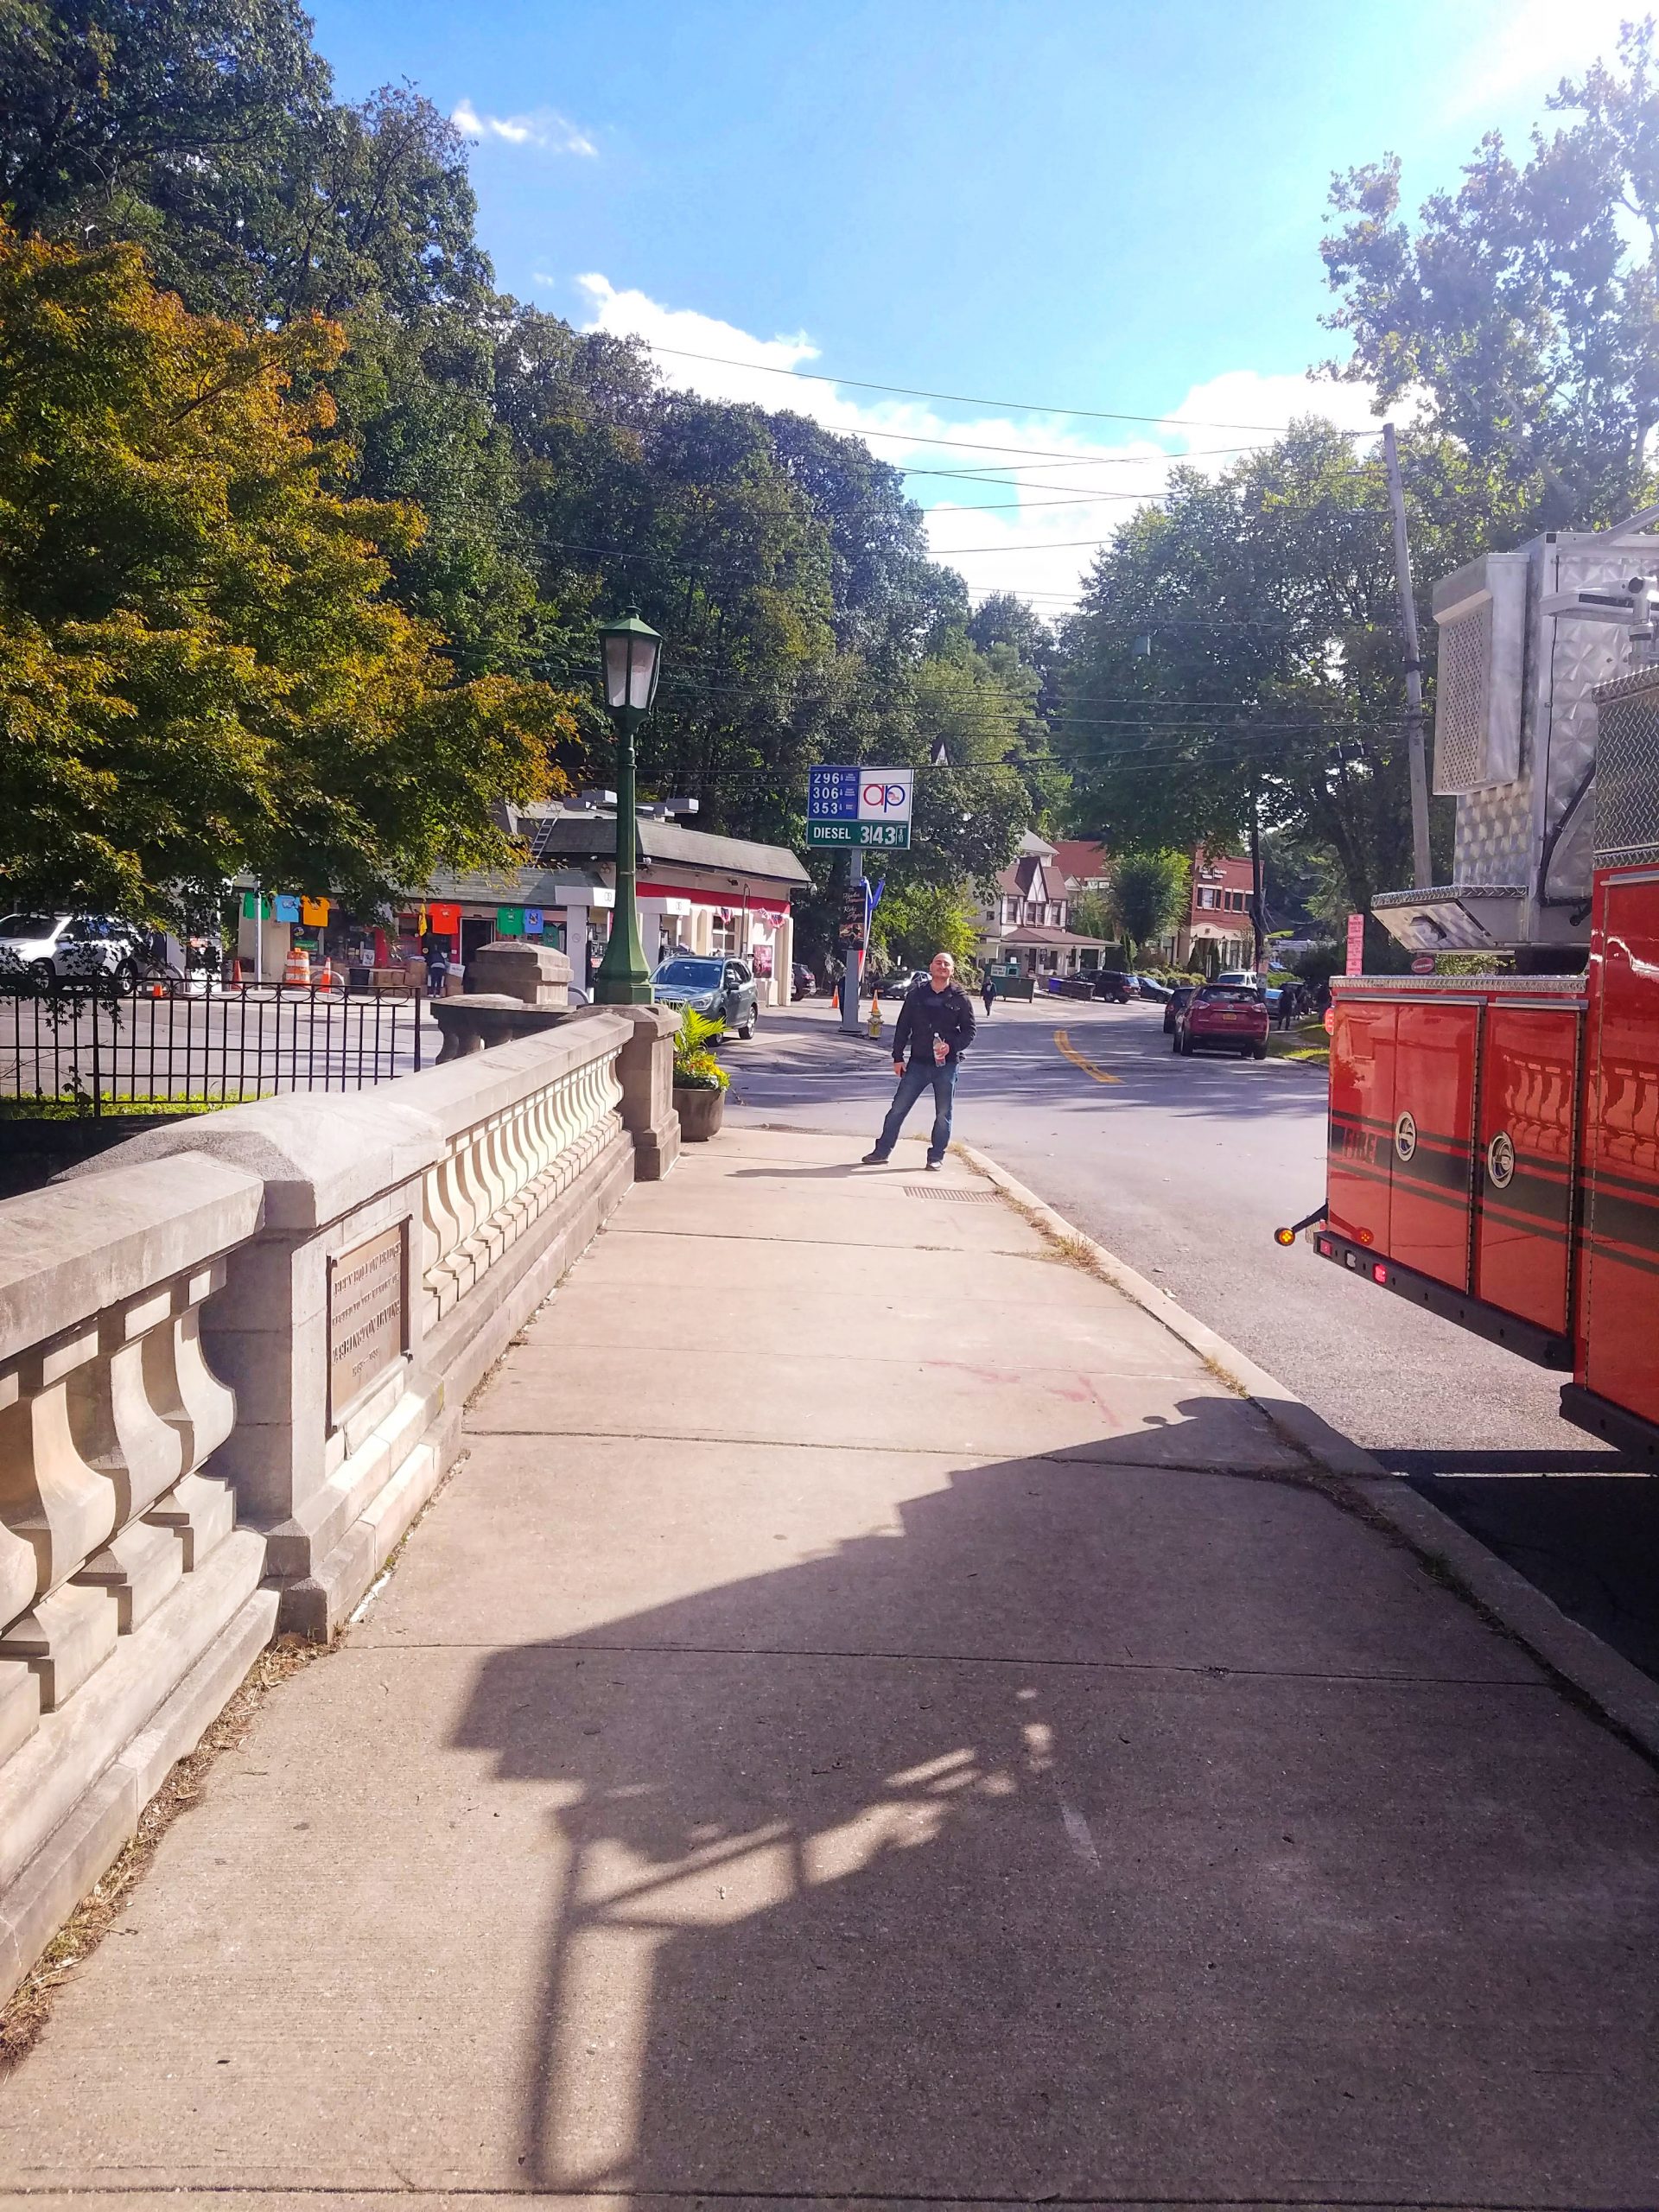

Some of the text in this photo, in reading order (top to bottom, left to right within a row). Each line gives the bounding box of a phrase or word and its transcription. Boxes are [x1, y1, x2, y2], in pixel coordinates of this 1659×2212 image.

[814, 772, 839, 785] 296
[812, 786, 838, 799] 306
[812, 802, 838, 815] 353
[813, 827, 851, 840] DIESEL
